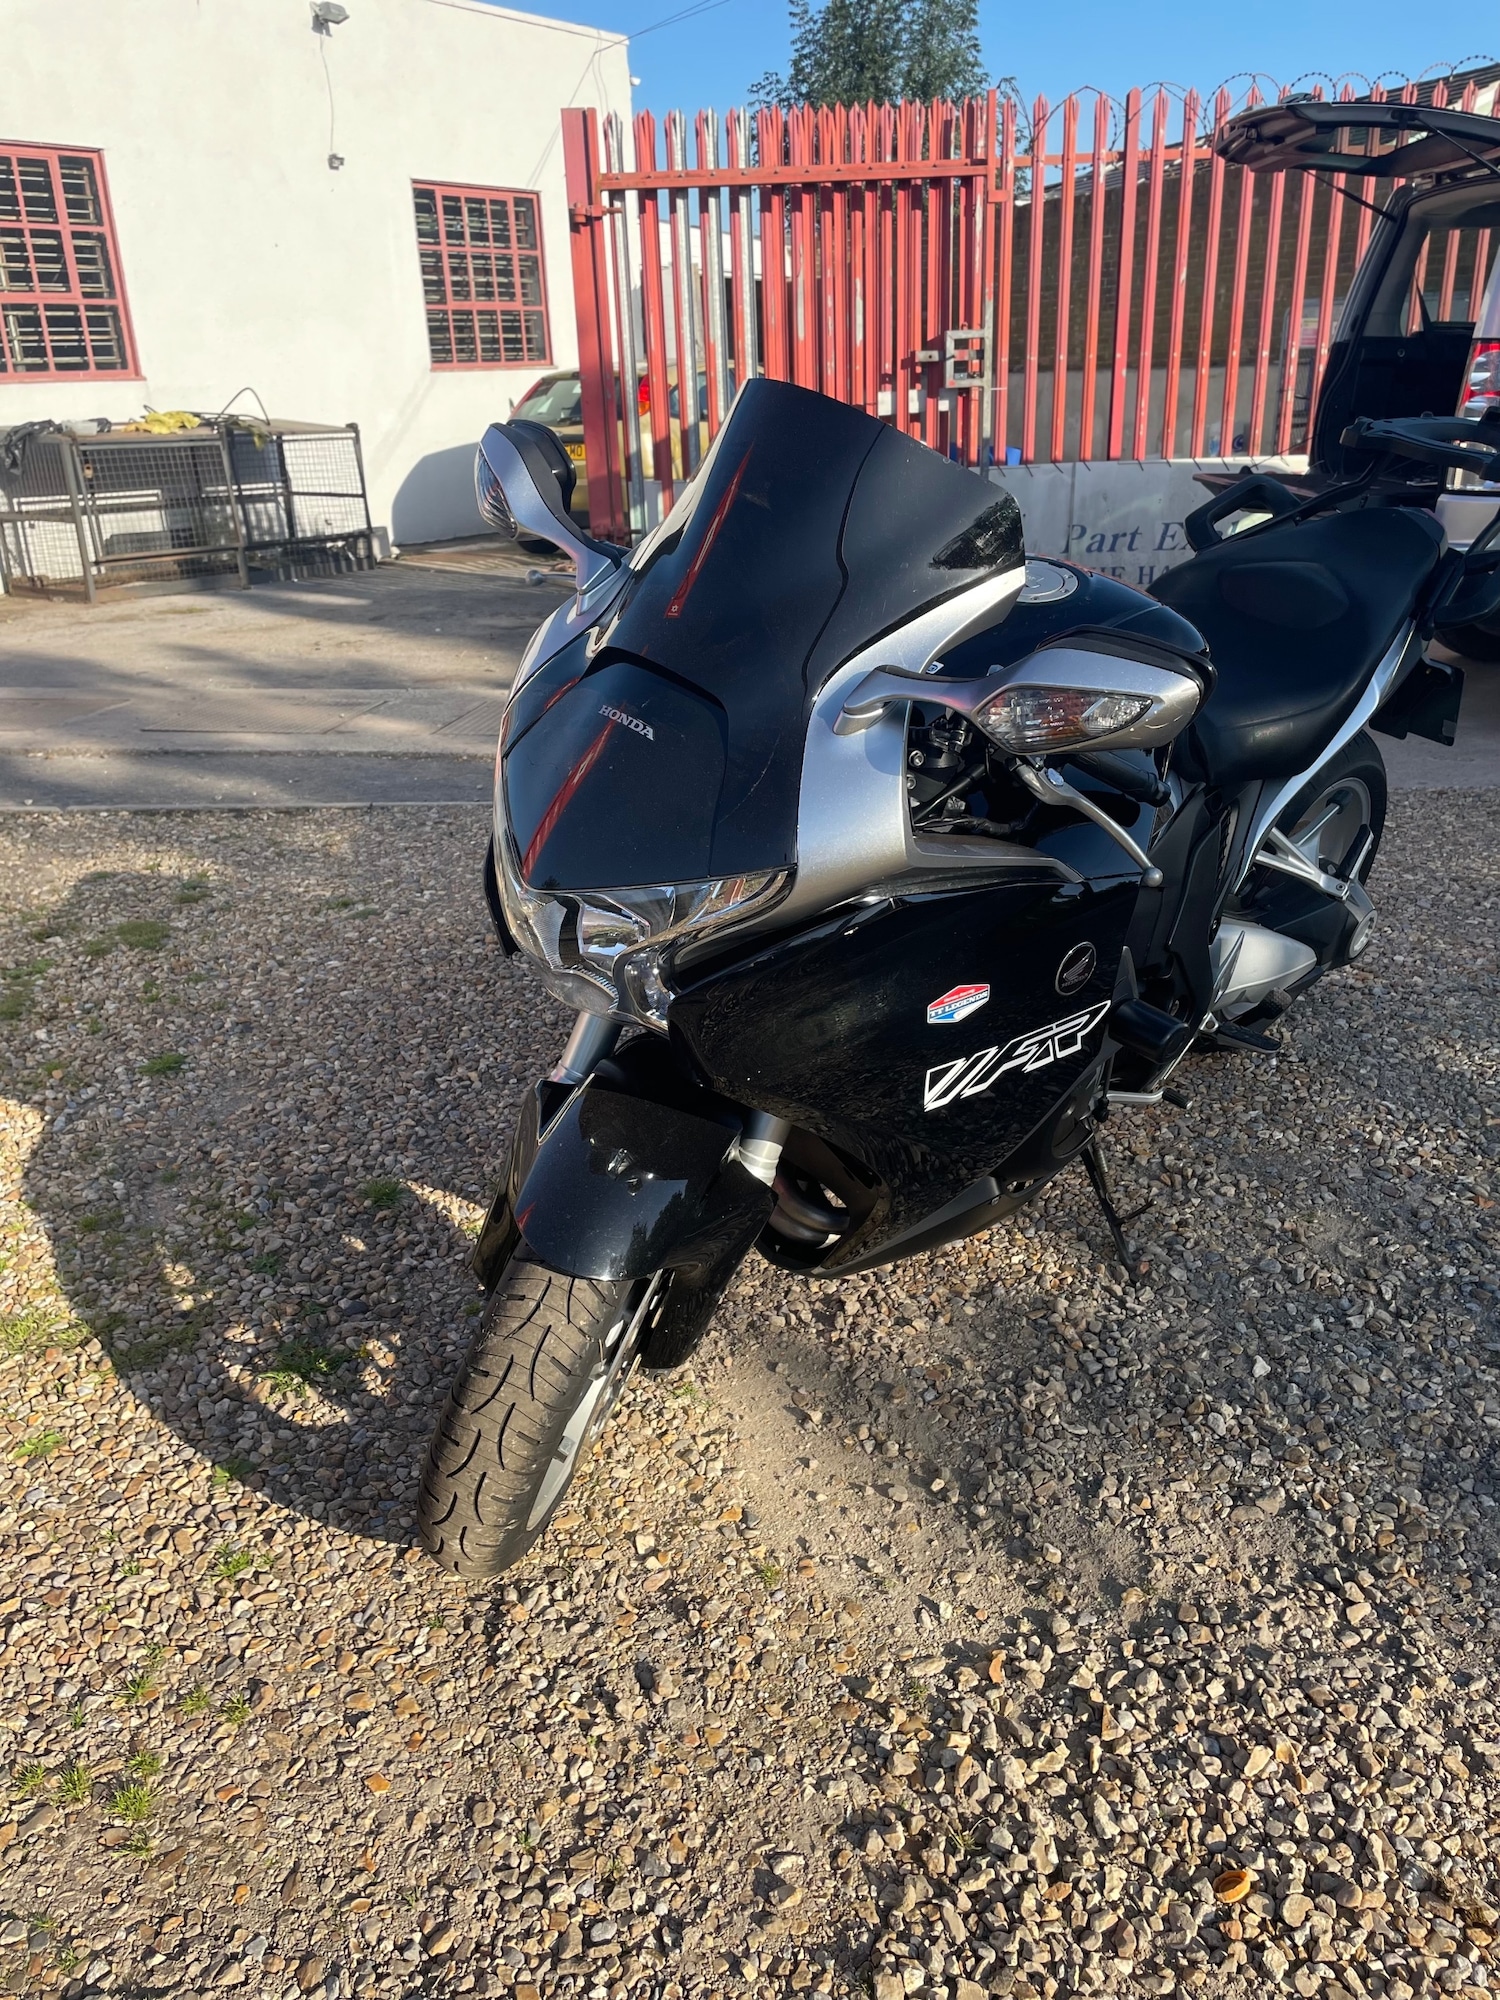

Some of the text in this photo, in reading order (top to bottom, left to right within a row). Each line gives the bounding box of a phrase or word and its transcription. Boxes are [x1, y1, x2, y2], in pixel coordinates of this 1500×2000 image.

[1060, 522, 1143, 554] Part
[598, 704, 655, 741] HONDA
[929, 1007, 945, 1018] TT
[944, 990, 988, 1013] LEGENDS
[924, 1000, 1111, 1112] VFR
